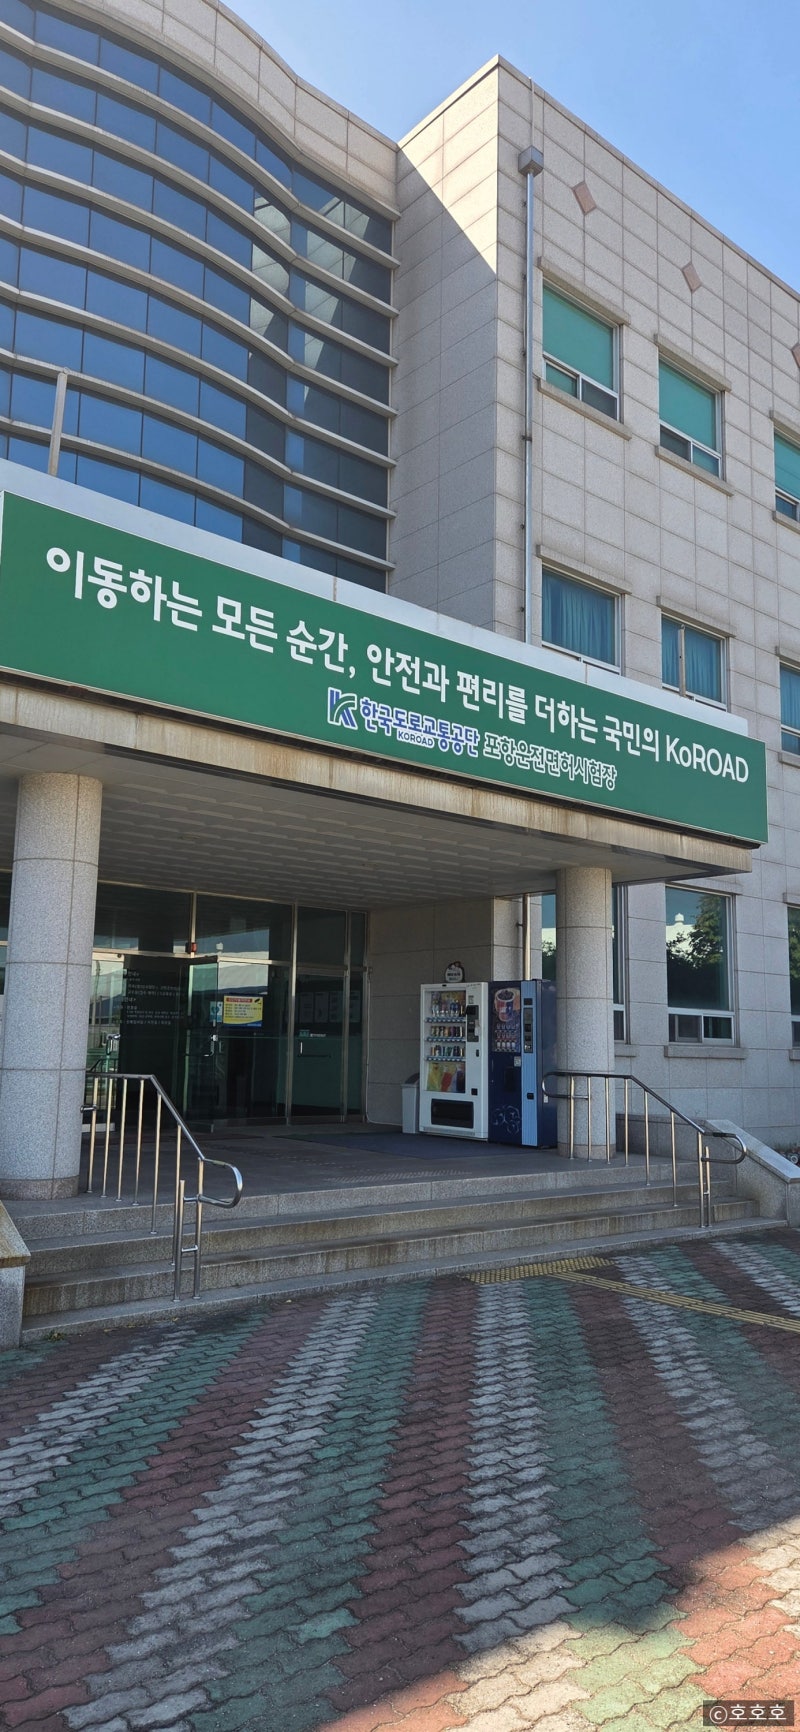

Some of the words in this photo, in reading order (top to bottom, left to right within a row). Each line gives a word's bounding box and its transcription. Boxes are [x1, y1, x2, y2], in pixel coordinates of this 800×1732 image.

[46, 547, 202, 632] 이동하는
[212, 595, 278, 653] 모든
[286, 620, 357, 678] 순간,
[366, 644, 450, 702] 안전과
[456, 670, 528, 725] 편리를
[535, 694, 598, 744] 더하는
[602, 715, 660, 762] 국민의
[666, 735, 749, 783] KoROAD
[360, 697, 479, 757] 한국도로교통공단
[483, 732, 617, 790] 포항운전면허시험장
[397, 730, 434, 748] KOROAD
